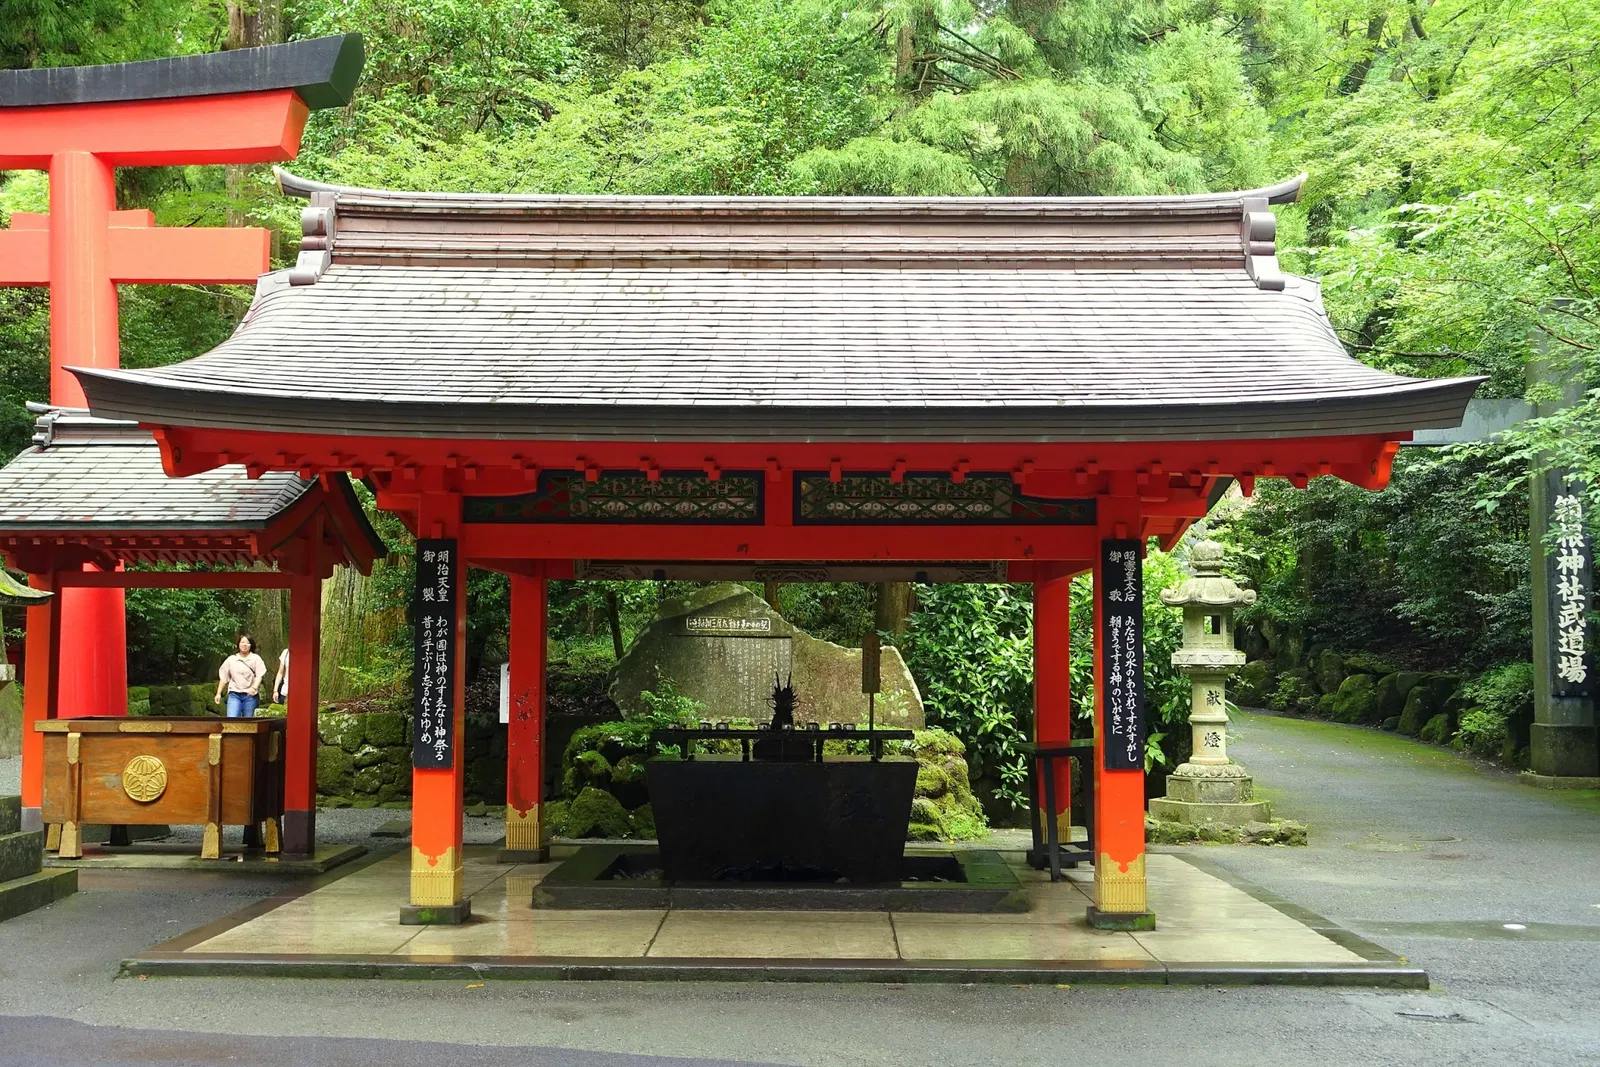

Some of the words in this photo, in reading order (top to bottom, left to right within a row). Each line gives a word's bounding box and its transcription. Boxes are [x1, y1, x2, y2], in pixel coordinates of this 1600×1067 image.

[436, 549, 450, 603] 明治天皇
[1123, 550, 1137, 603] 昭憲皇太后
